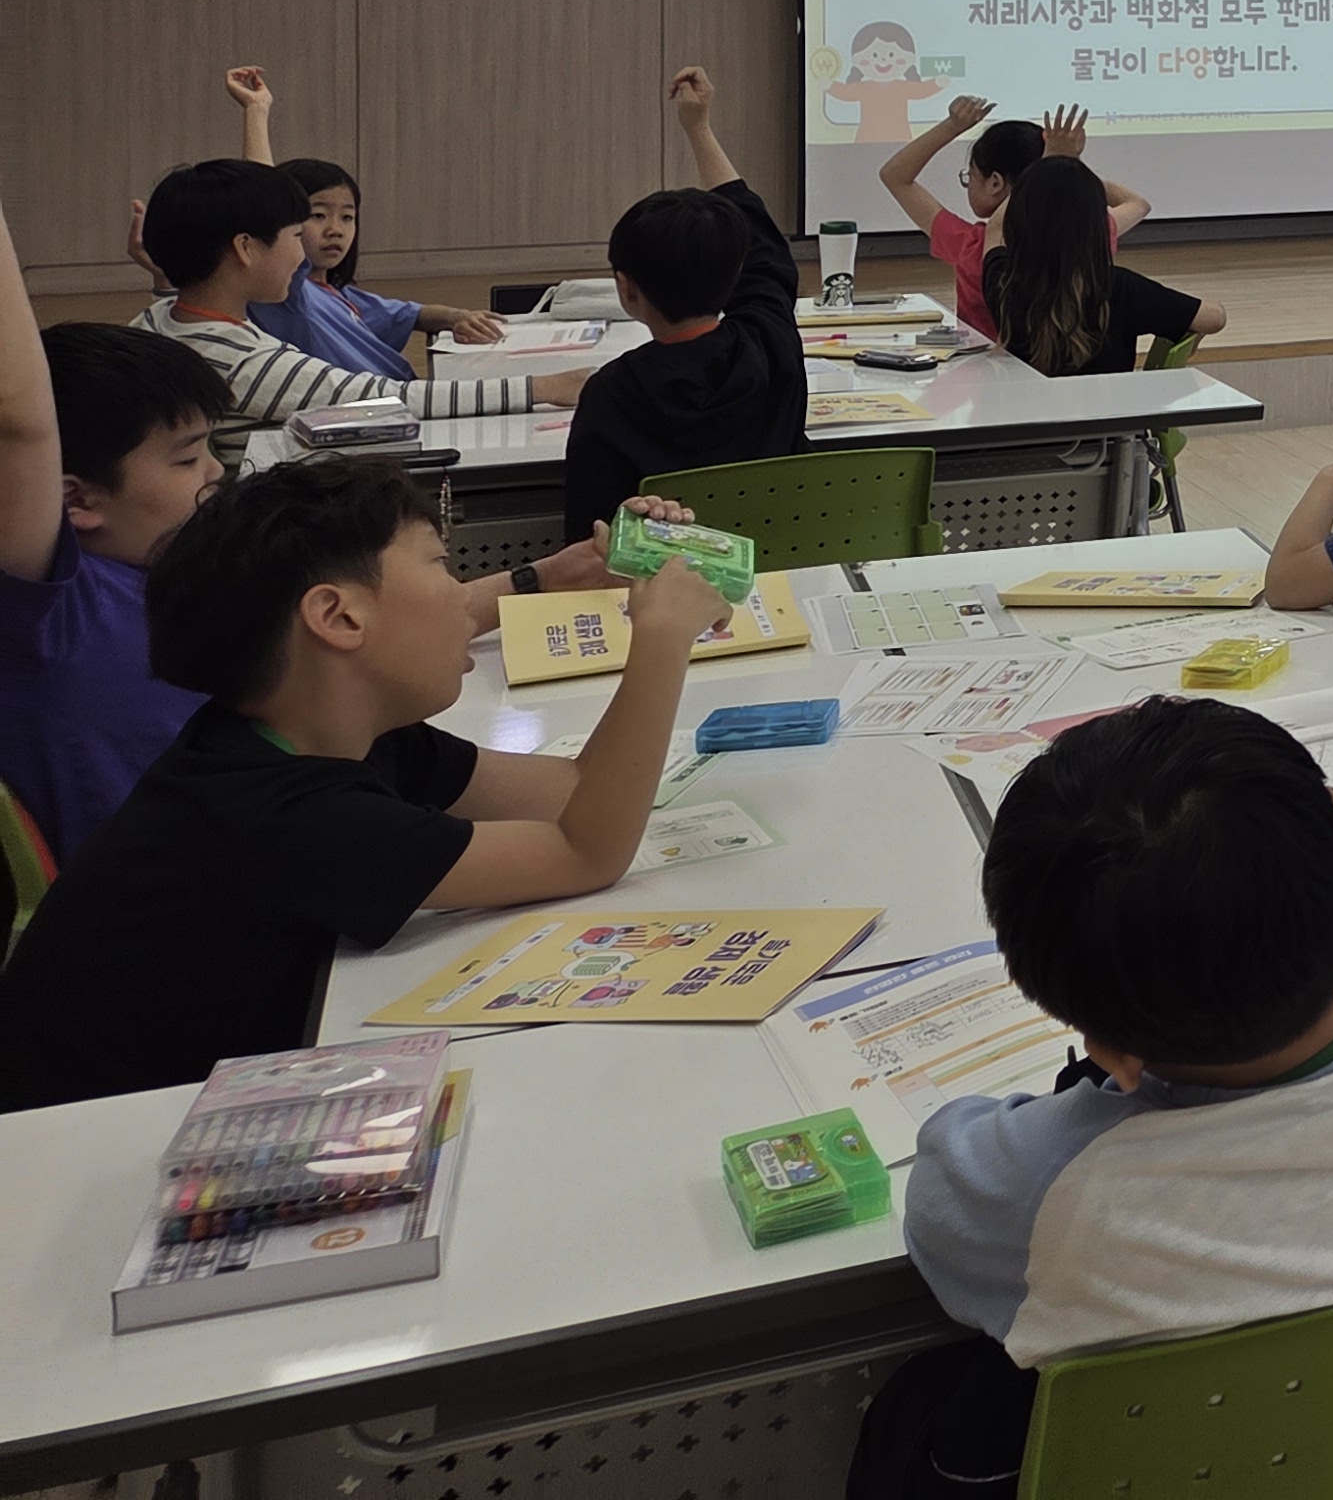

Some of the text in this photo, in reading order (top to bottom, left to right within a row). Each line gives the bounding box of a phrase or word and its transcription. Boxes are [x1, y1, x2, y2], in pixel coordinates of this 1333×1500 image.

[1070, 45, 1299, 82] 물건이 다양합니다.
[573, 613, 605, 639] 생활
[662, 930, 768, 996] 경제 생활
[721, 938, 792, 988] 슬기로운
